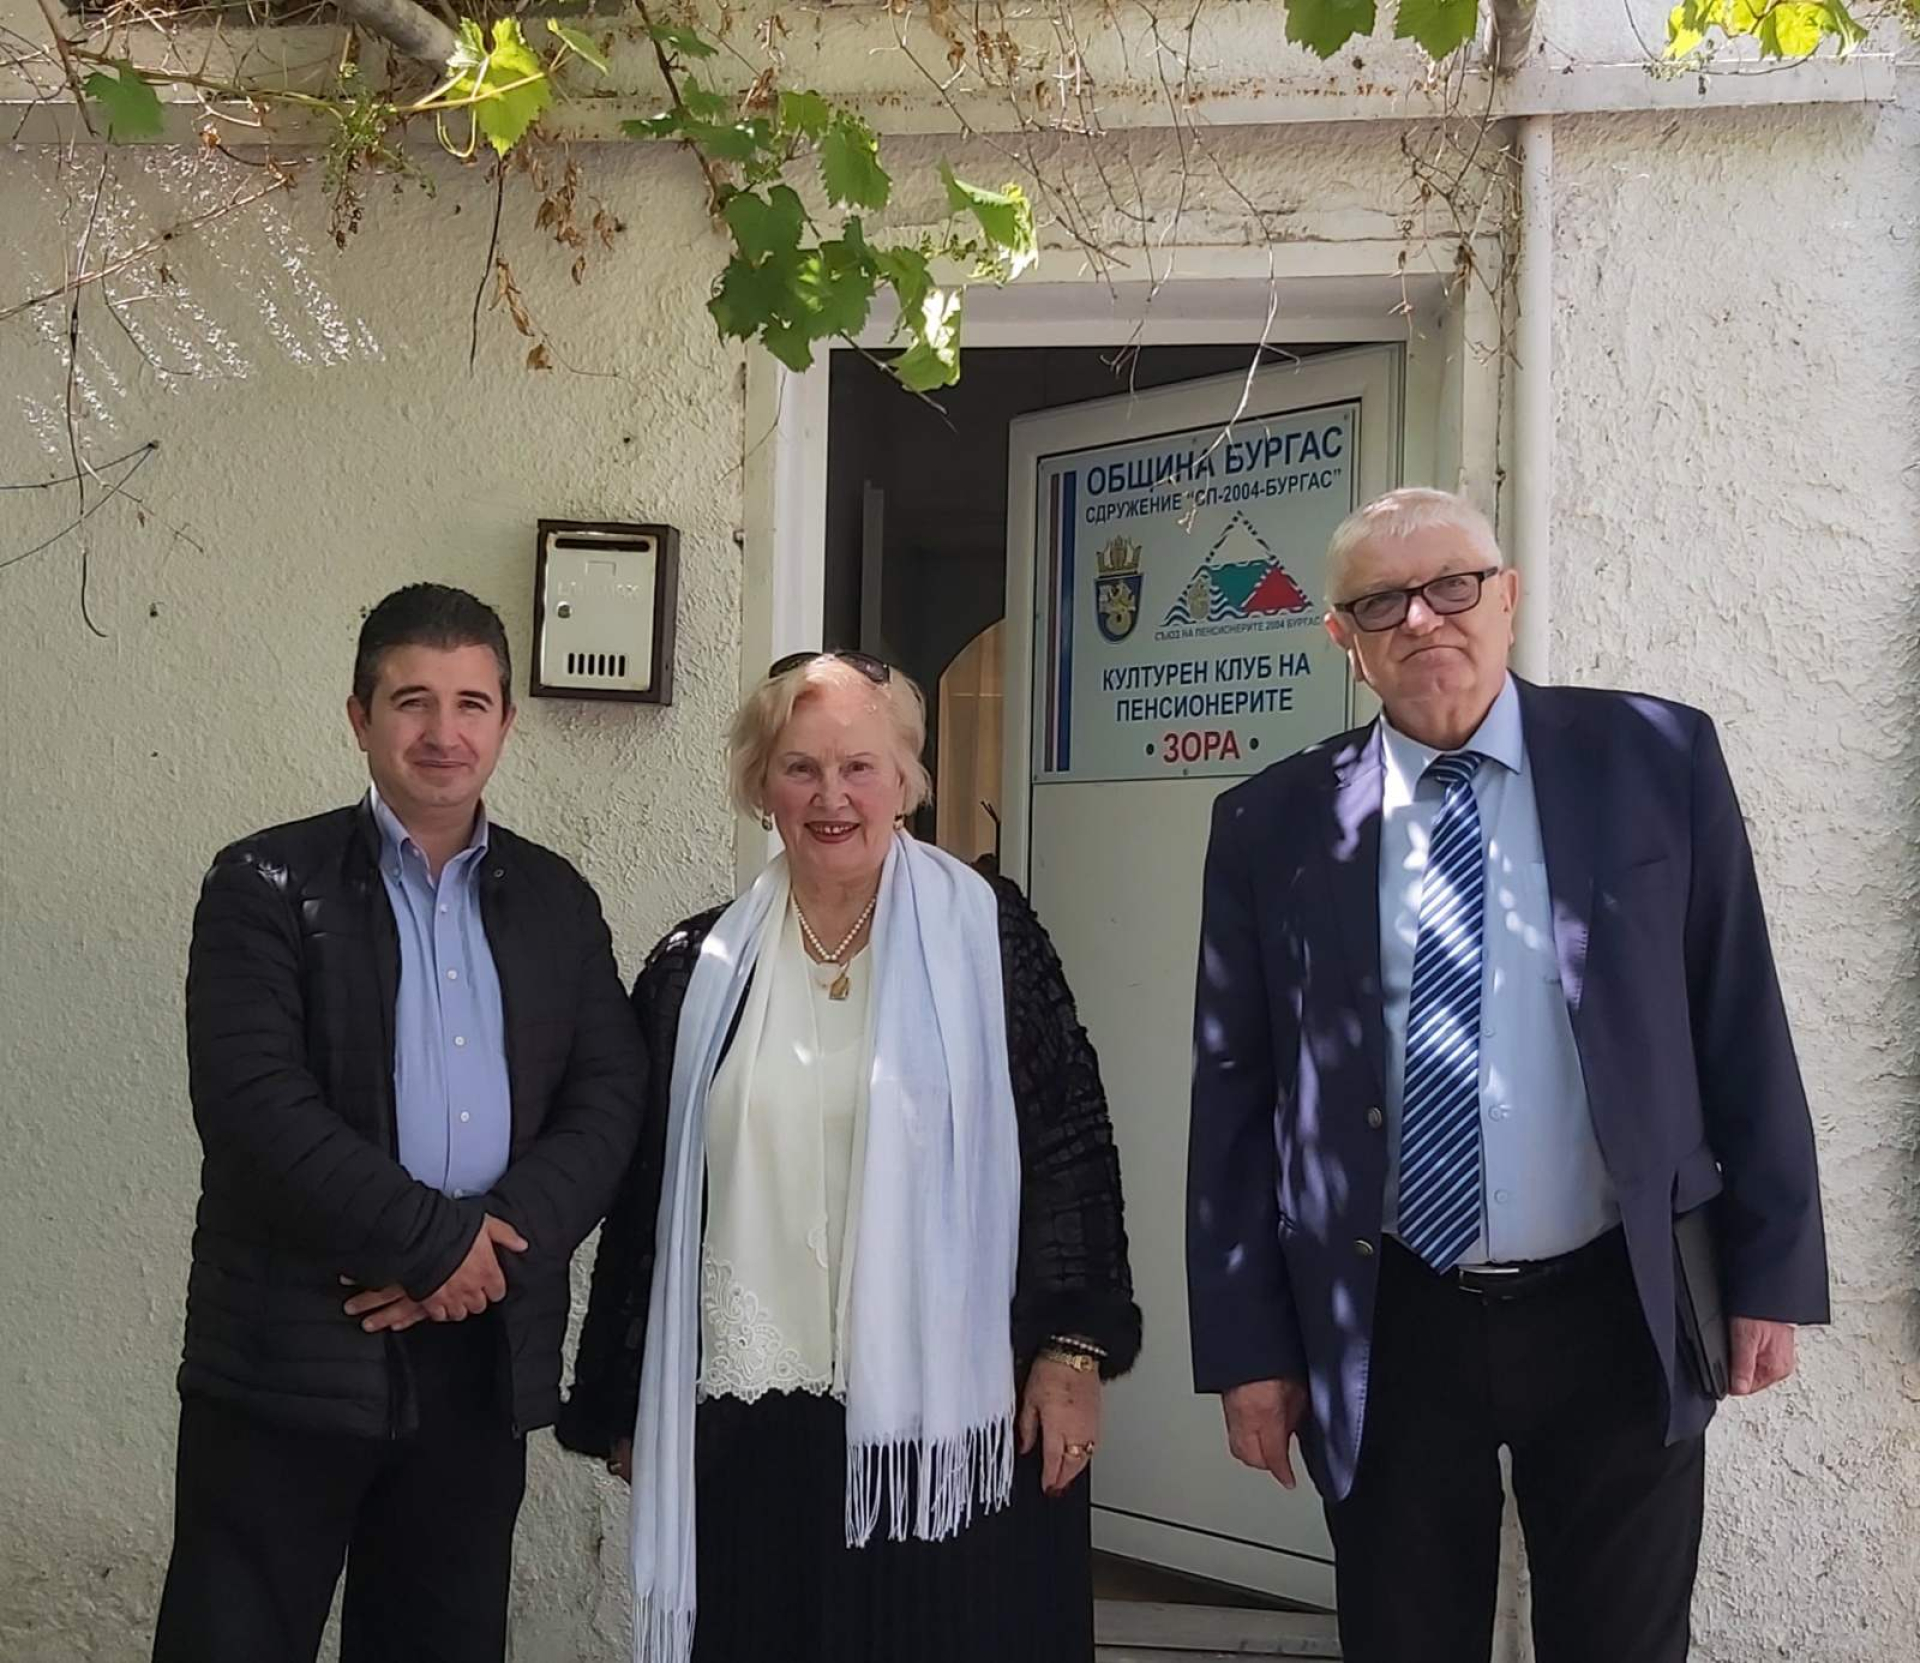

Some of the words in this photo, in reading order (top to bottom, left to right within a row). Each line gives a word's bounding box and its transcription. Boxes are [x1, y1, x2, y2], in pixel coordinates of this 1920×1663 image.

[1087, 447, 1215, 496] ОБЩИНА
[1225, 426, 1343, 475] БУРГАС
[1085, 493, 1182, 524] СДРУЖЕНИЕ
[1195, 621, 1265, 638] ПЕНСИОНЕРИТЕ
[1265, 619, 1285, 631] 2004
[1103, 660, 1208, 691] КУЛТУРЕН
[1215, 655, 1272, 683] КЛУБ
[1279, 652, 1311, 678] НА
[1116, 687, 1293, 722] ПЕНСИОНЕРИТЕ
[1163, 729, 1241, 764] ЗОРА
